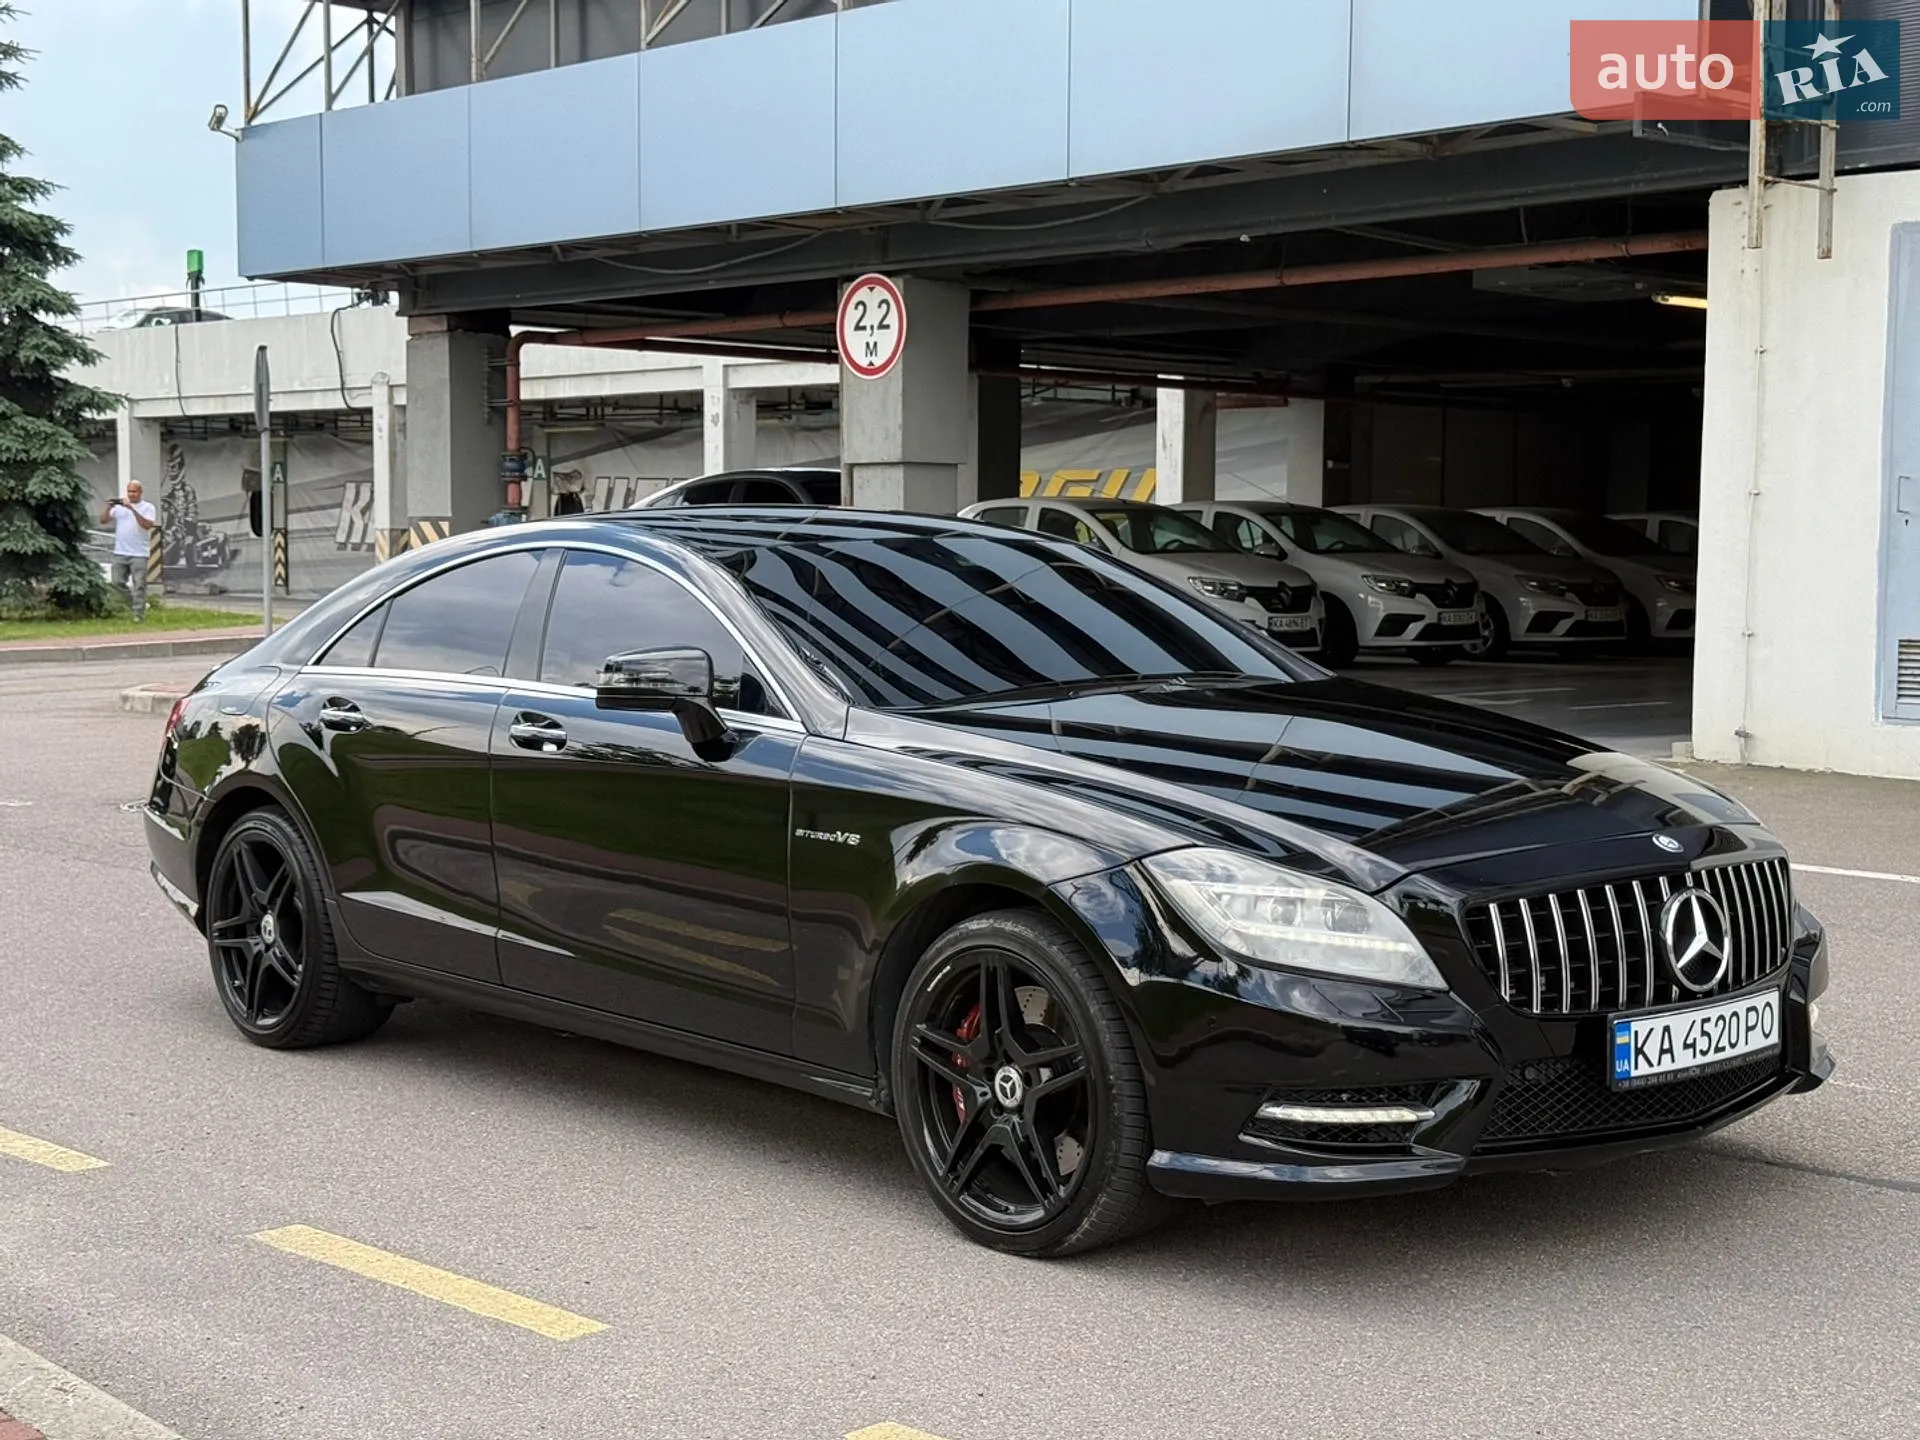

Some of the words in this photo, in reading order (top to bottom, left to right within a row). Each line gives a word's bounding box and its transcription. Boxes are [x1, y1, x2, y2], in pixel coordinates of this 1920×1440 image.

[853, 298, 891, 337] 2,2
[272, 463, 284, 482] A
[532, 458, 547, 479] A
[1634, 1024, 1675, 1071] KA
[1682, 1010, 1740, 1059] 4520
[1744, 1001, 1774, 1046] PO
[1616, 1059, 1631, 1072] UA
